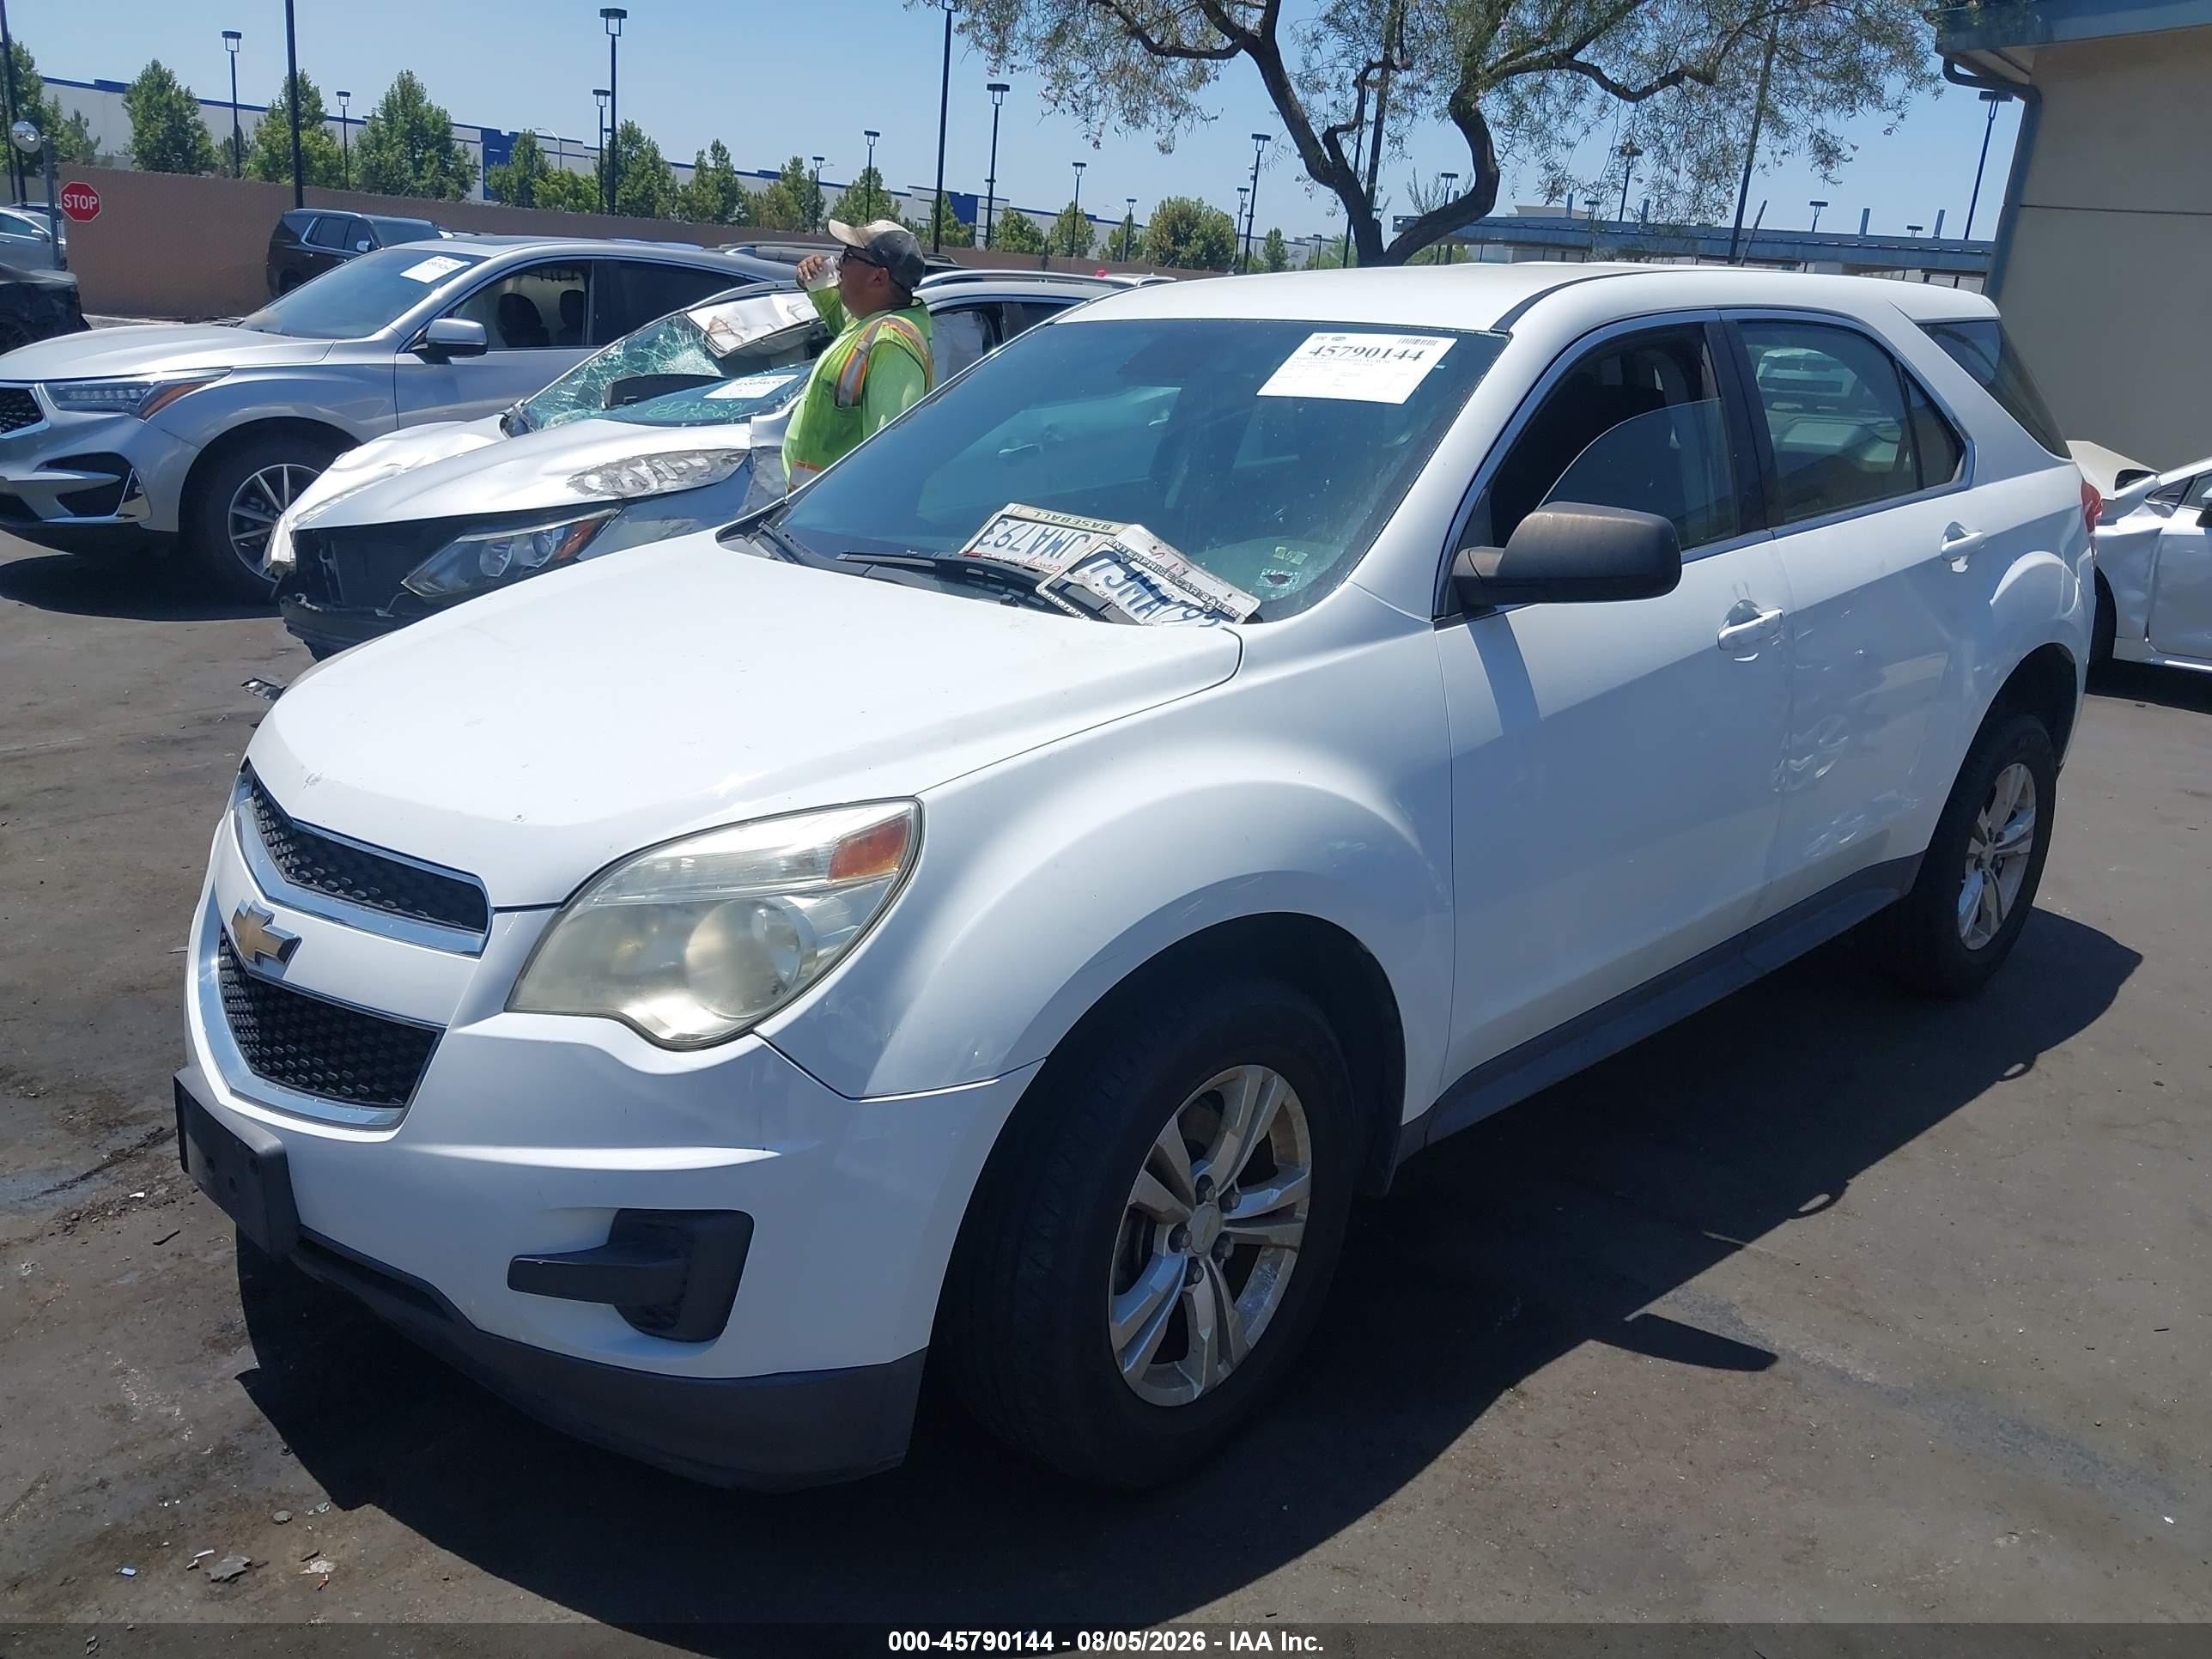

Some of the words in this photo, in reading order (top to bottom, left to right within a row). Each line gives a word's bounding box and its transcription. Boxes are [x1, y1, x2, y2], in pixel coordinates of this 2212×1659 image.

[63, 193, 98, 210] STOP
[1309, 344, 1426, 362] 45790144
[1032, 510, 1114, 531] BASEBALL
[1105, 537, 1176, 582] ENTERPRISE
[1174, 576, 1200, 596] CAR
[1200, 592, 1240, 618] SALES
